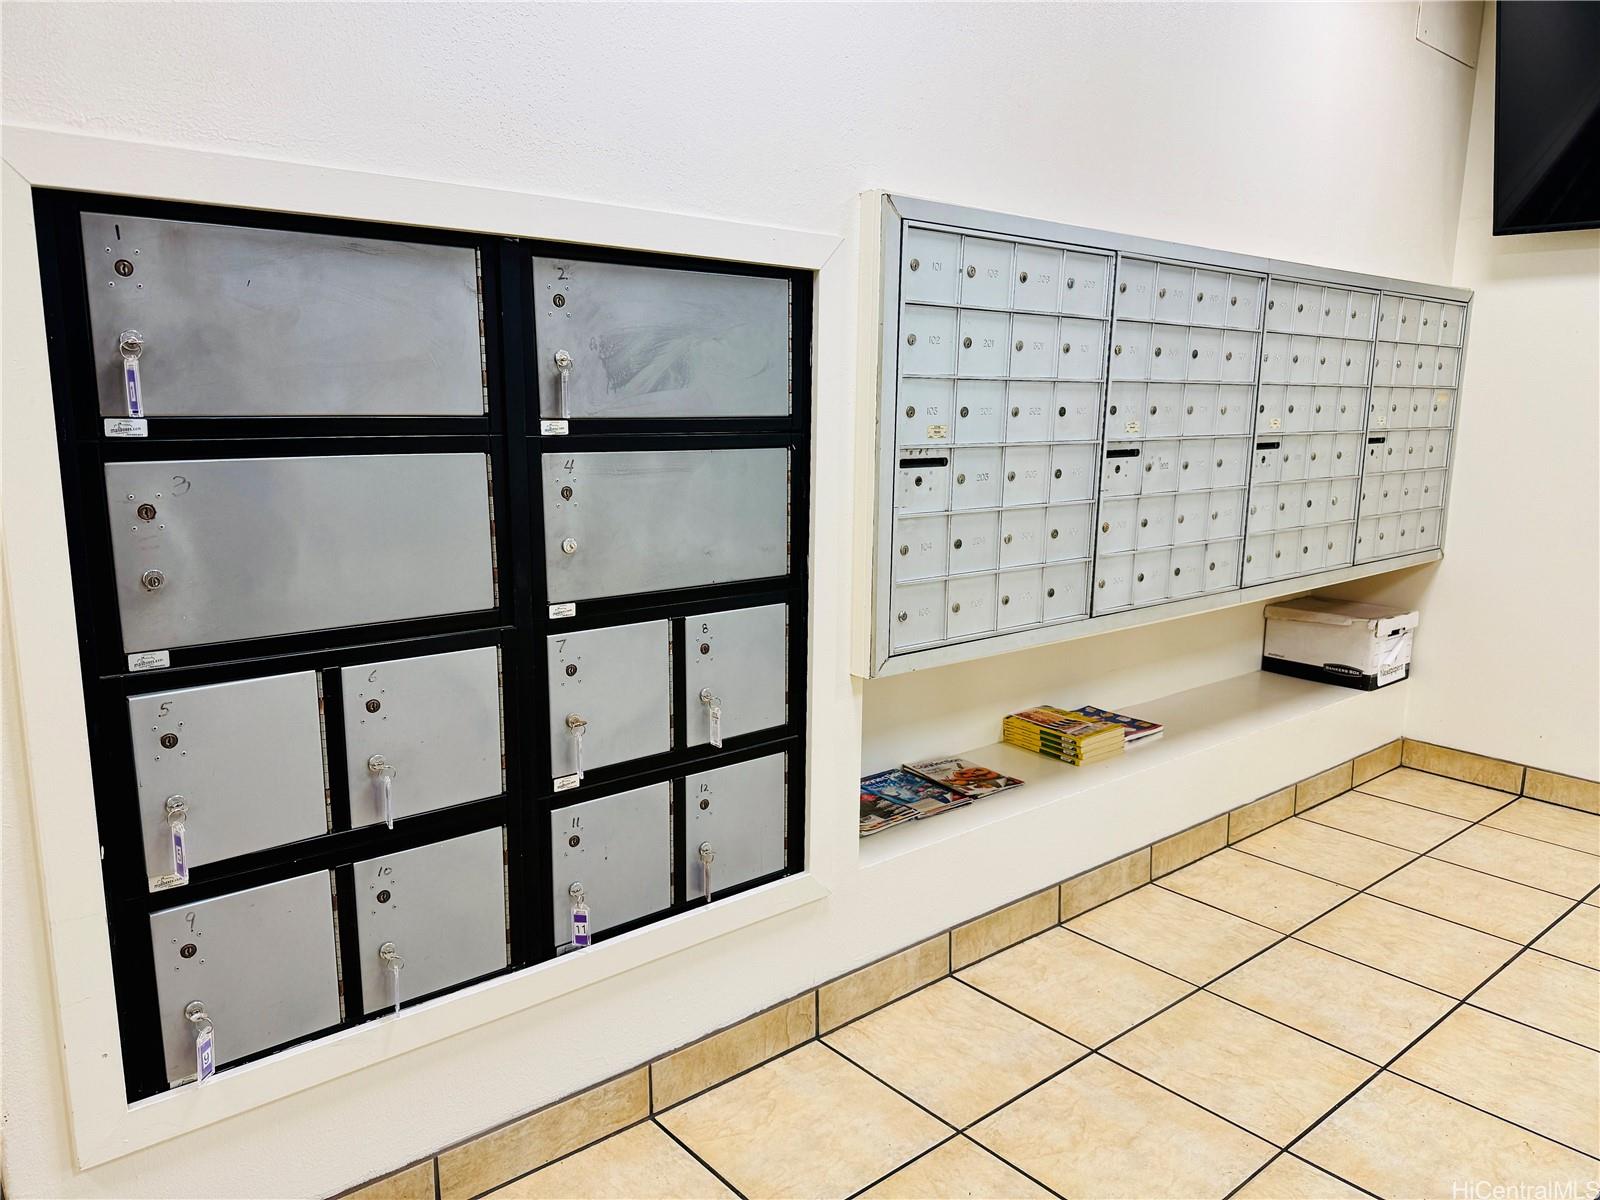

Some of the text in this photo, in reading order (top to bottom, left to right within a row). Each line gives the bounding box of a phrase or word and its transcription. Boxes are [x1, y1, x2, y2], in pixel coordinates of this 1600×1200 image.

[114, 224, 121, 241] 1
[931, 261, 943, 272] 101
[556, 267, 568, 280] 2
[928, 335, 941, 345] 102
[563, 458, 575, 474] 4
[976, 472, 989, 482] 203
[171, 475, 192, 498] 3
[701, 623, 709, 634] 8
[555, 638, 568, 653] 7
[367, 669, 377, 683] 6
[157, 701, 173, 718] 5
[699, 783, 710, 793] 12
[571, 817, 581, 829] 11
[377, 866, 393, 877] 10
[184, 911, 196, 932] 9
[575, 924, 587, 934] 11
